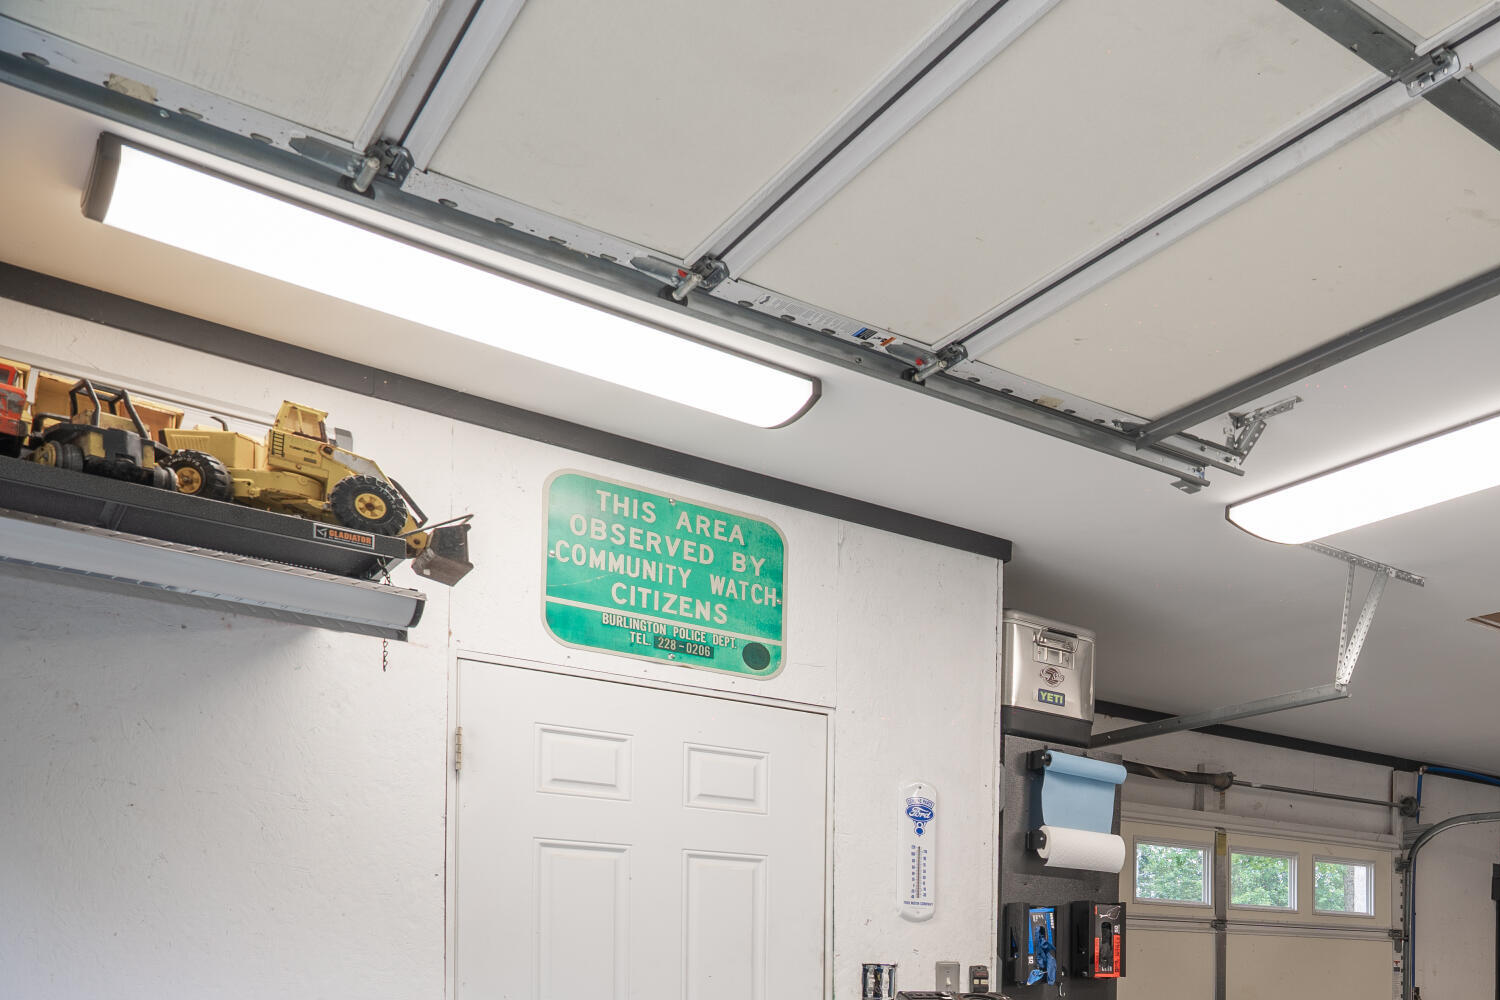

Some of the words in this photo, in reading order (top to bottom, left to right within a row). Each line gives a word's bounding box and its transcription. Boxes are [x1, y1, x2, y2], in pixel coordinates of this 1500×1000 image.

[596, 489, 657, 524] THIS
[676, 511, 746, 546] AREA
[329, 529, 372, 545] GLADIATOR
[569, 513, 715, 566] OBSERVED
[732, 551, 766, 577] BY
[555, 540, 692, 589] COMMUNITY
[709, 573, 777, 607] WATCH
[611, 582, 728, 625] CITIZENS
[602, 612, 667, 636] BURLINGTON
[673, 626, 707, 643] POLICE
[712, 633, 737, 649] DEPT.
[629, 631, 651, 646] TEL.
[1040, 691, 1063, 704] YETI
[908, 806, 932, 818] Ford
